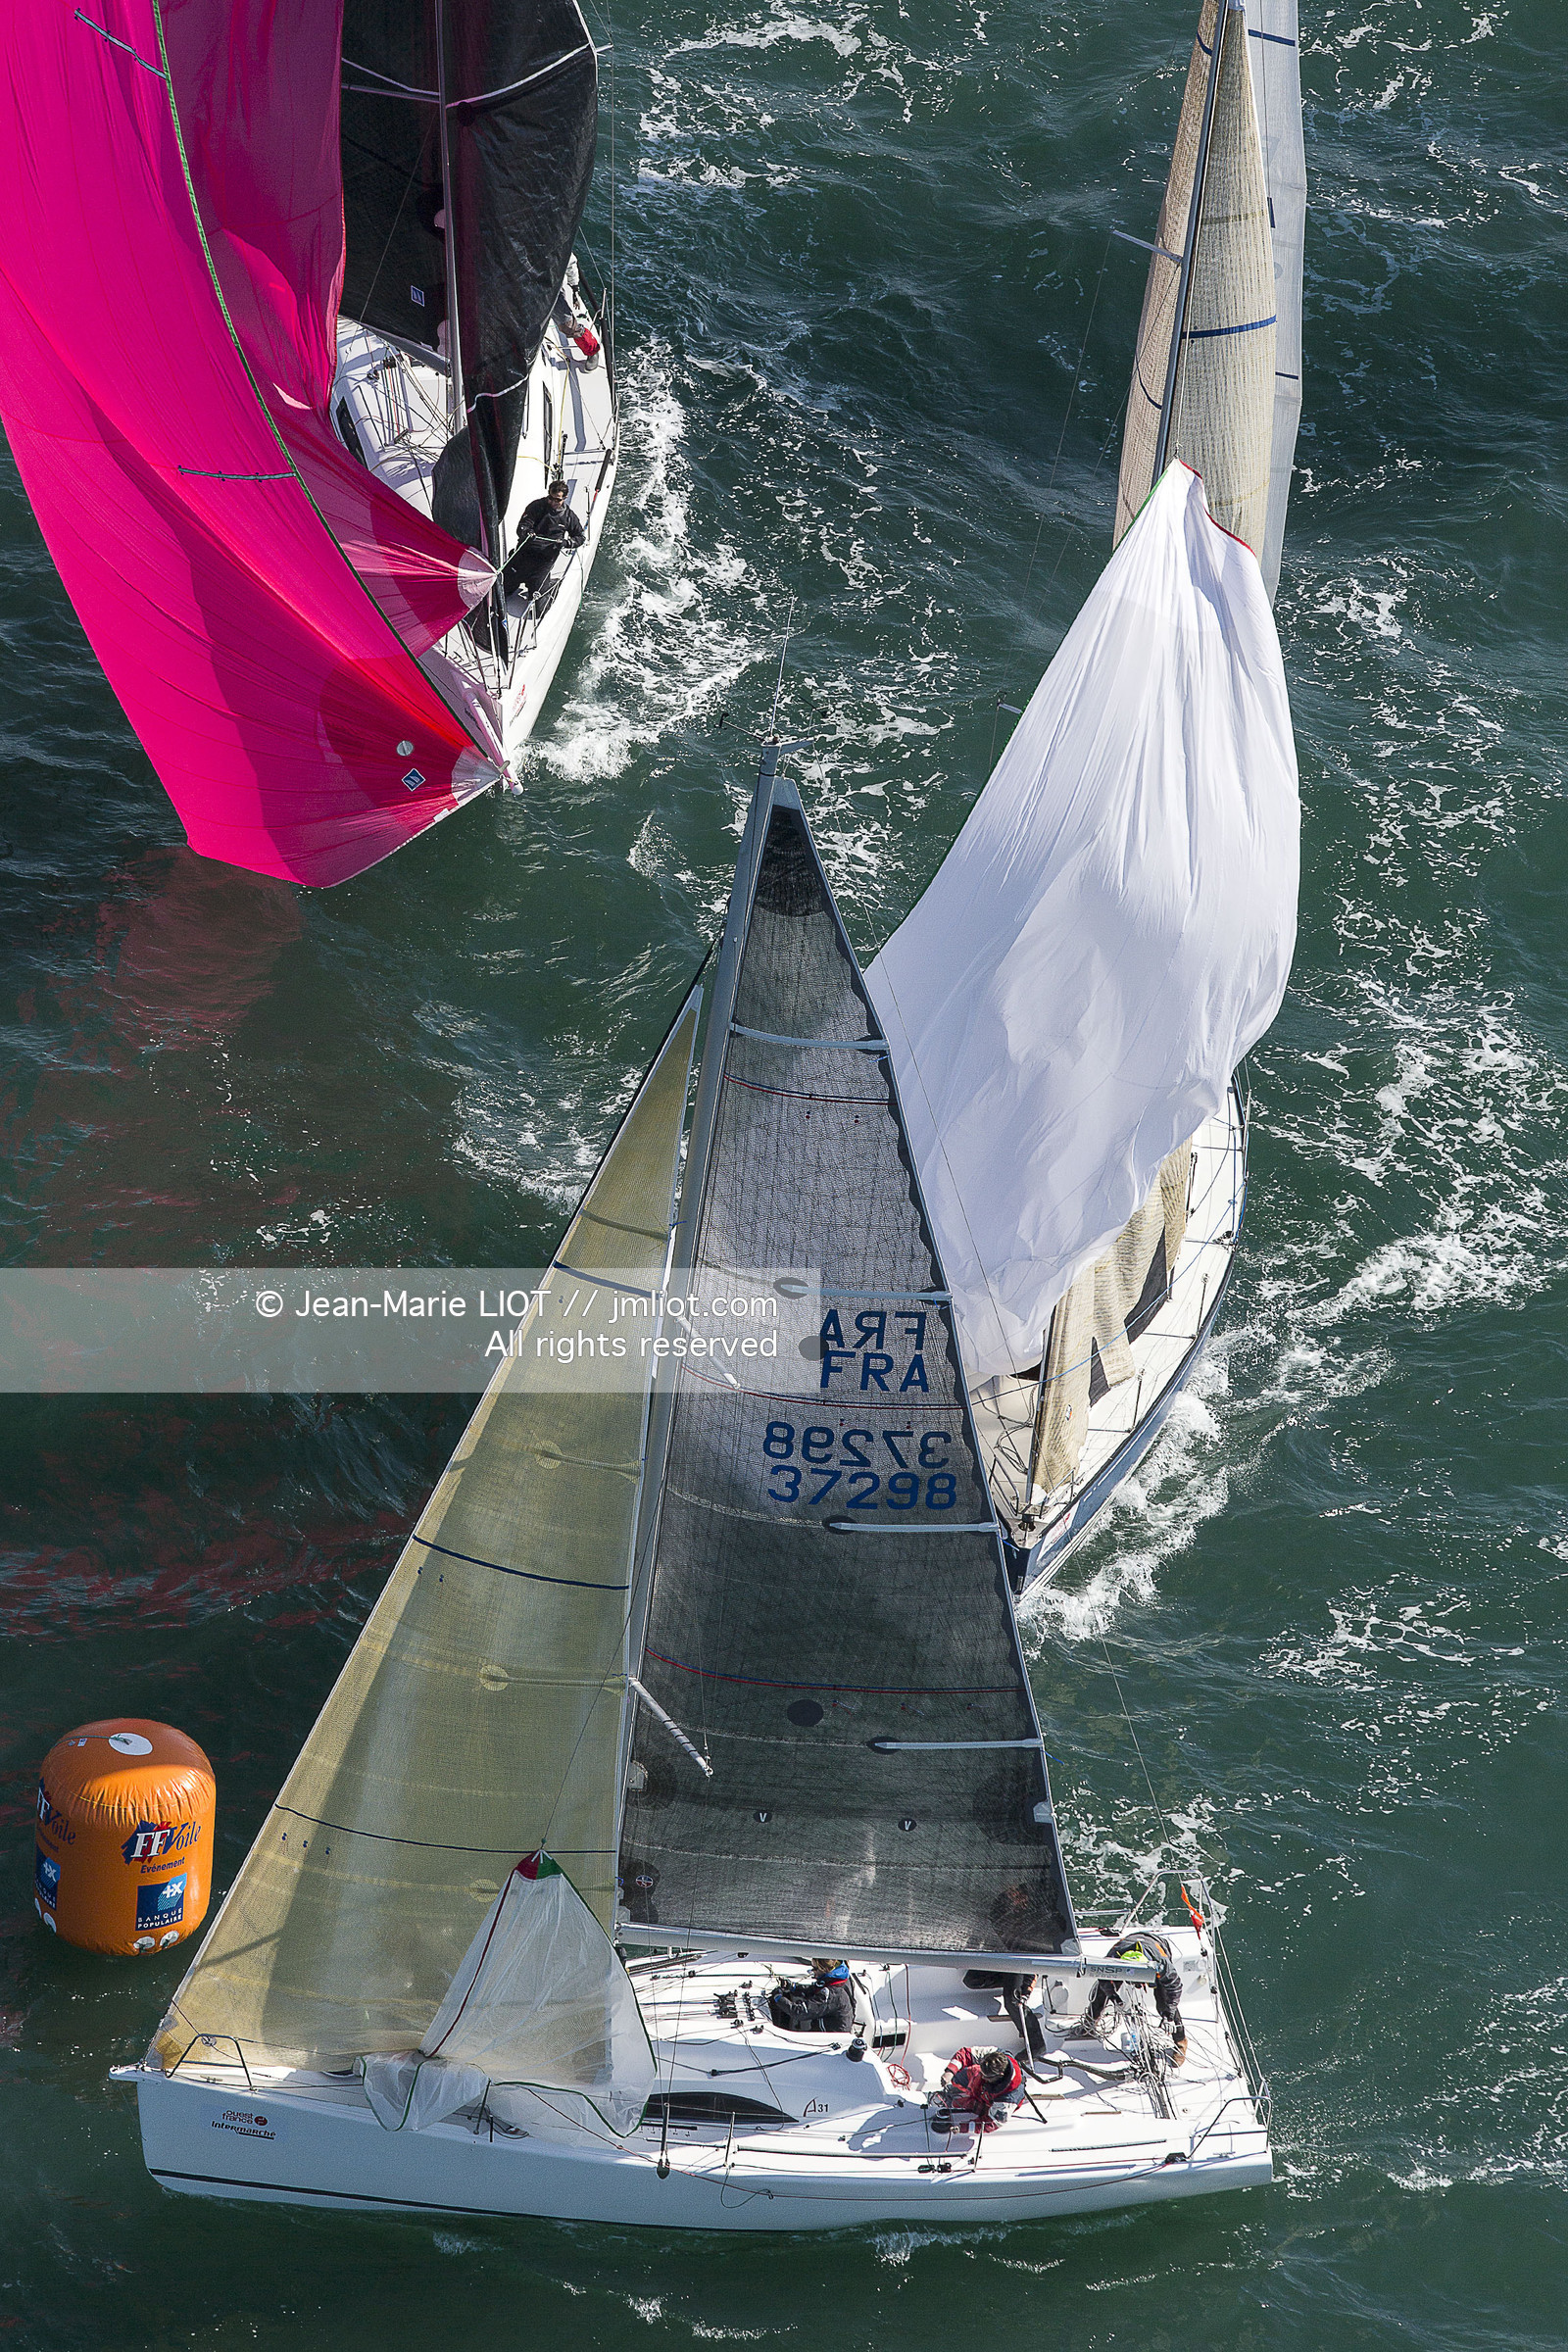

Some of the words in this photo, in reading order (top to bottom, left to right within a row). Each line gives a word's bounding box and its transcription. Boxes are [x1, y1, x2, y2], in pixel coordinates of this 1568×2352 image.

[820, 1351, 929, 1392] FRA
[767, 1465, 956, 1510] 37298
[137, 1914, 182, 1929] POPULAIRE
[138, 1907, 182, 1923] BANQUE
[221, 2112, 253, 2125] france
[225, 2110, 254, 2119] ouest
